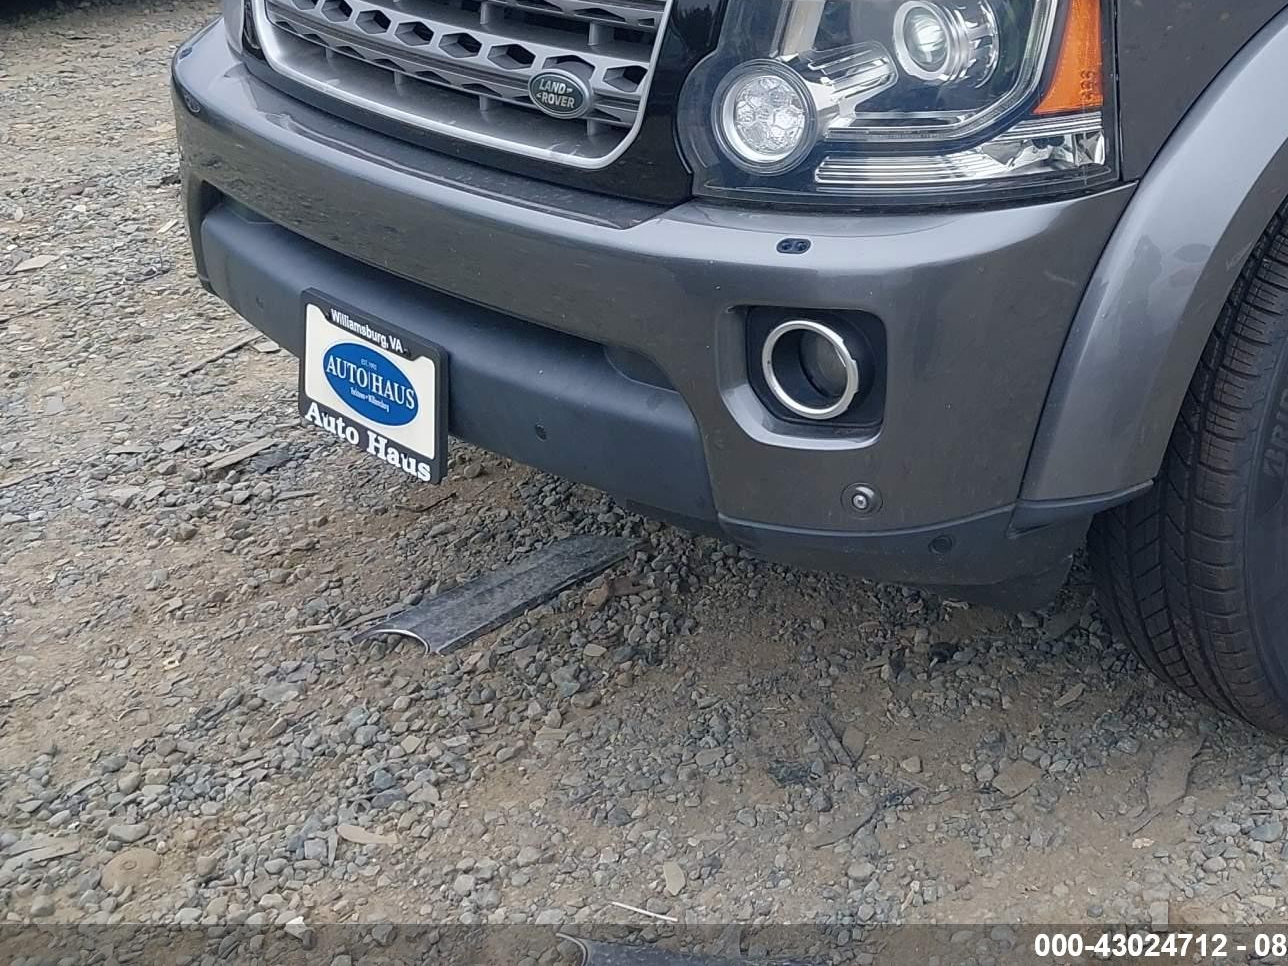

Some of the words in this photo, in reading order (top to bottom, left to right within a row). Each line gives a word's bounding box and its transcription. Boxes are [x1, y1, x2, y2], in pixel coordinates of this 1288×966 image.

[539, 78, 566, 94] LAND
[541, 92, 575, 109] ROVER
[331, 308, 389, 349] Williamsburg,
[388, 335, 404, 353] VA
[326, 355, 367, 388] AUTO
[371, 373, 415, 409] HAUS
[305, 402, 359, 445] Auto
[367, 431, 431, 482] Haus
